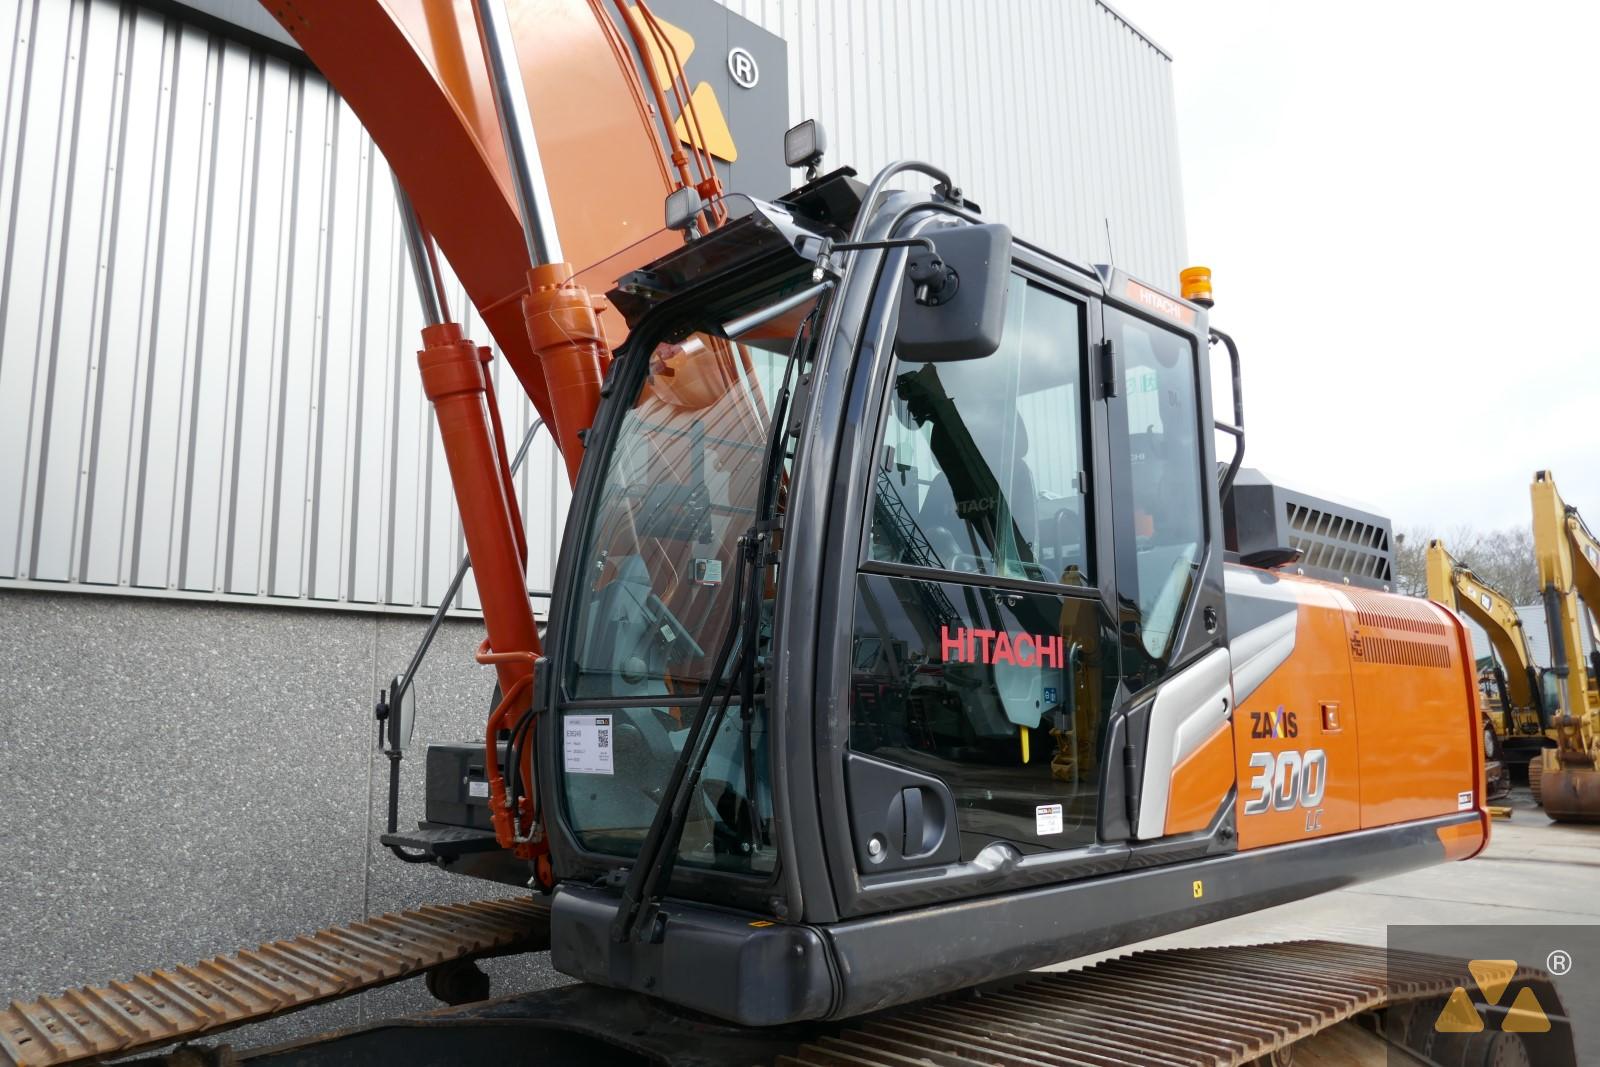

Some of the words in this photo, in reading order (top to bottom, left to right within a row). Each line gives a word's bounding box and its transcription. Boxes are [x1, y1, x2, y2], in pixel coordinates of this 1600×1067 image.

[1140, 289, 1181, 320] HITACHI
[941, 625, 1064, 669] HITACHI
[1250, 705, 1298, 739] ZAXIS
[1245, 748, 1327, 815] 300
[1305, 808, 1324, 833] LC
